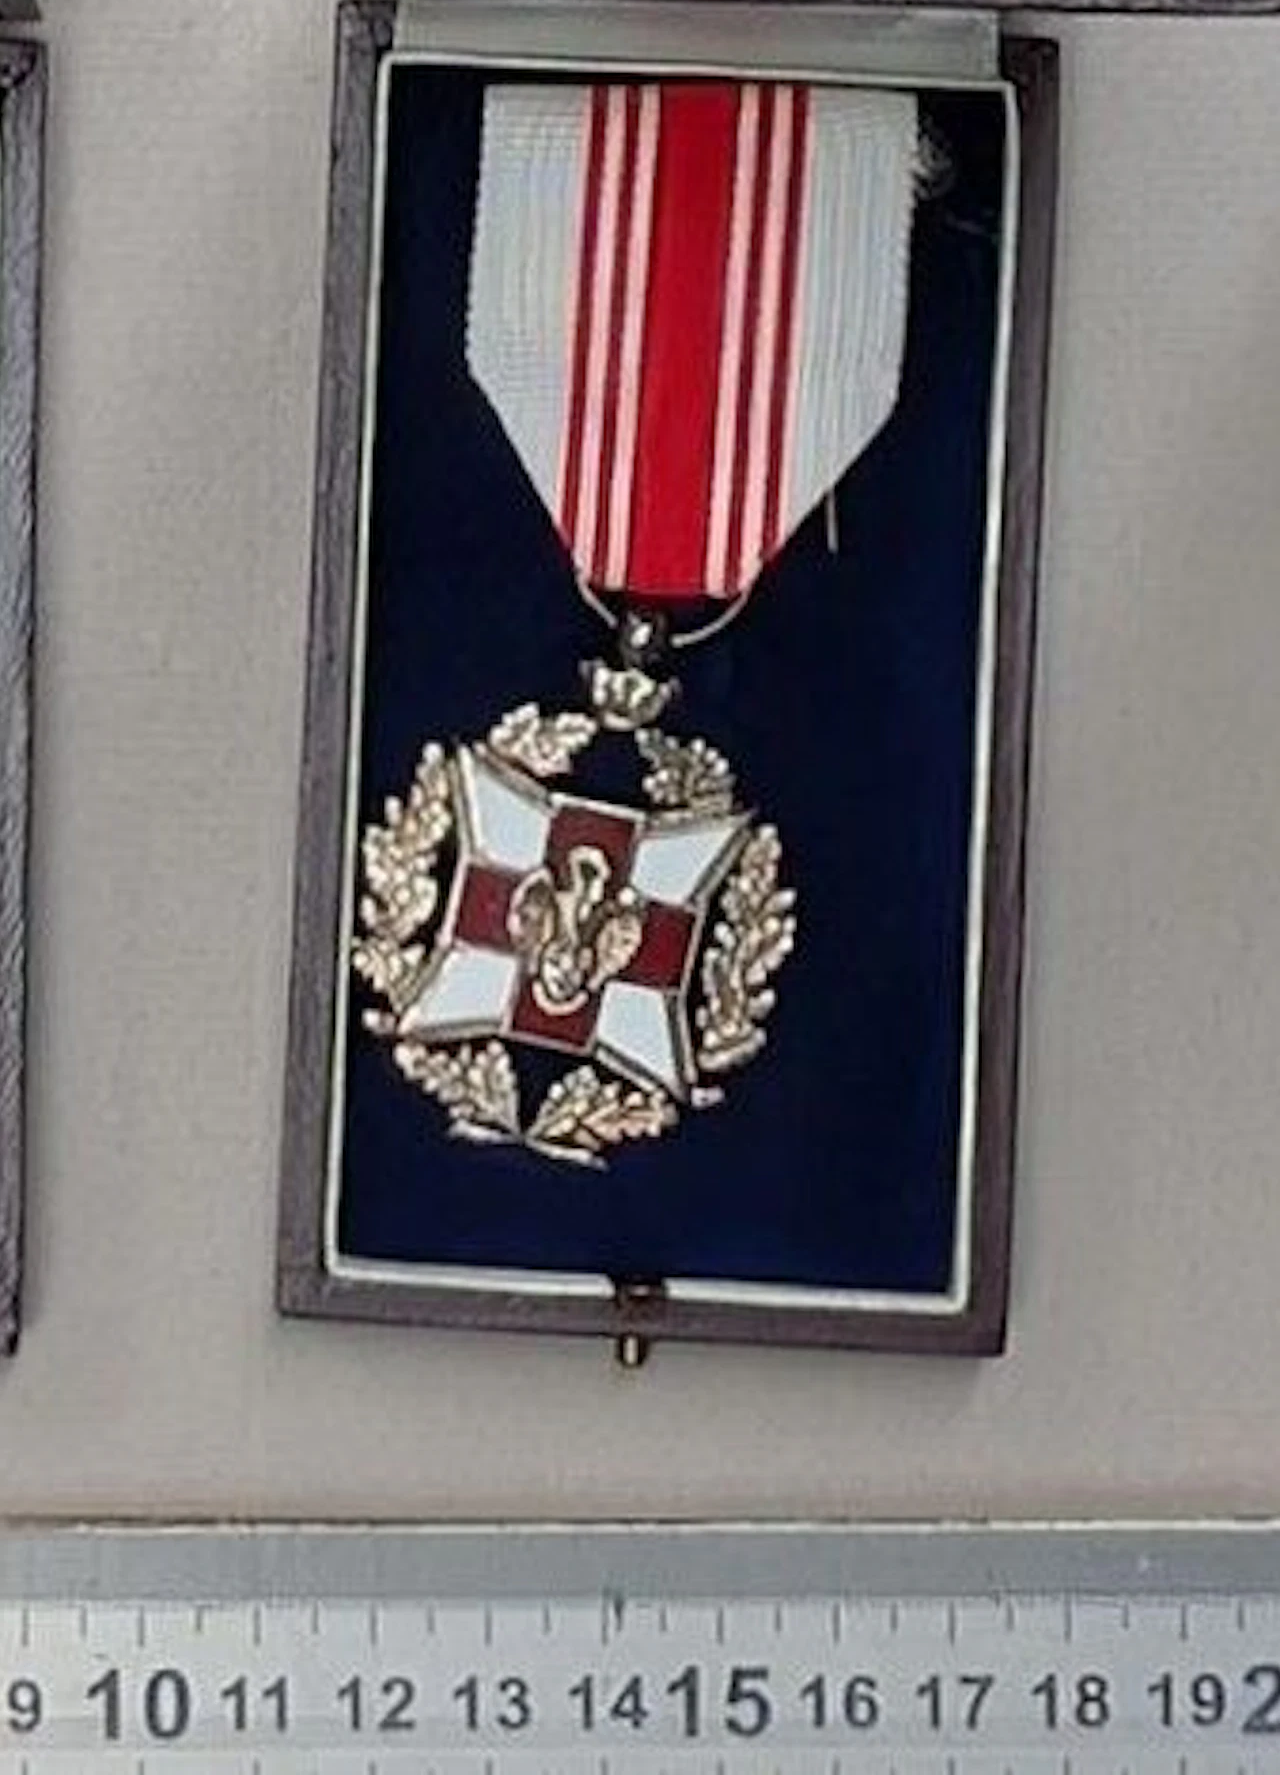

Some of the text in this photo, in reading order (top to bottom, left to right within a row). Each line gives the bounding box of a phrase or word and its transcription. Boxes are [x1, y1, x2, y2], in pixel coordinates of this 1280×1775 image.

[8, 1679, 42, 1733] 9
[87, 1668, 190, 1740] 10
[221, 1677, 287, 1732] 11
[338, 1676, 415, 1732] 12
[454, 1676, 531, 1731] 13
[569, 1675, 648, 1730] 14
[667, 1666, 771, 1738] 15
[800, 1674, 879, 1729] 16
[917, 1675, 994, 1729] 17
[1032, 1673, 1110, 1729] 18
[1148, 1673, 1226, 1727] 19
